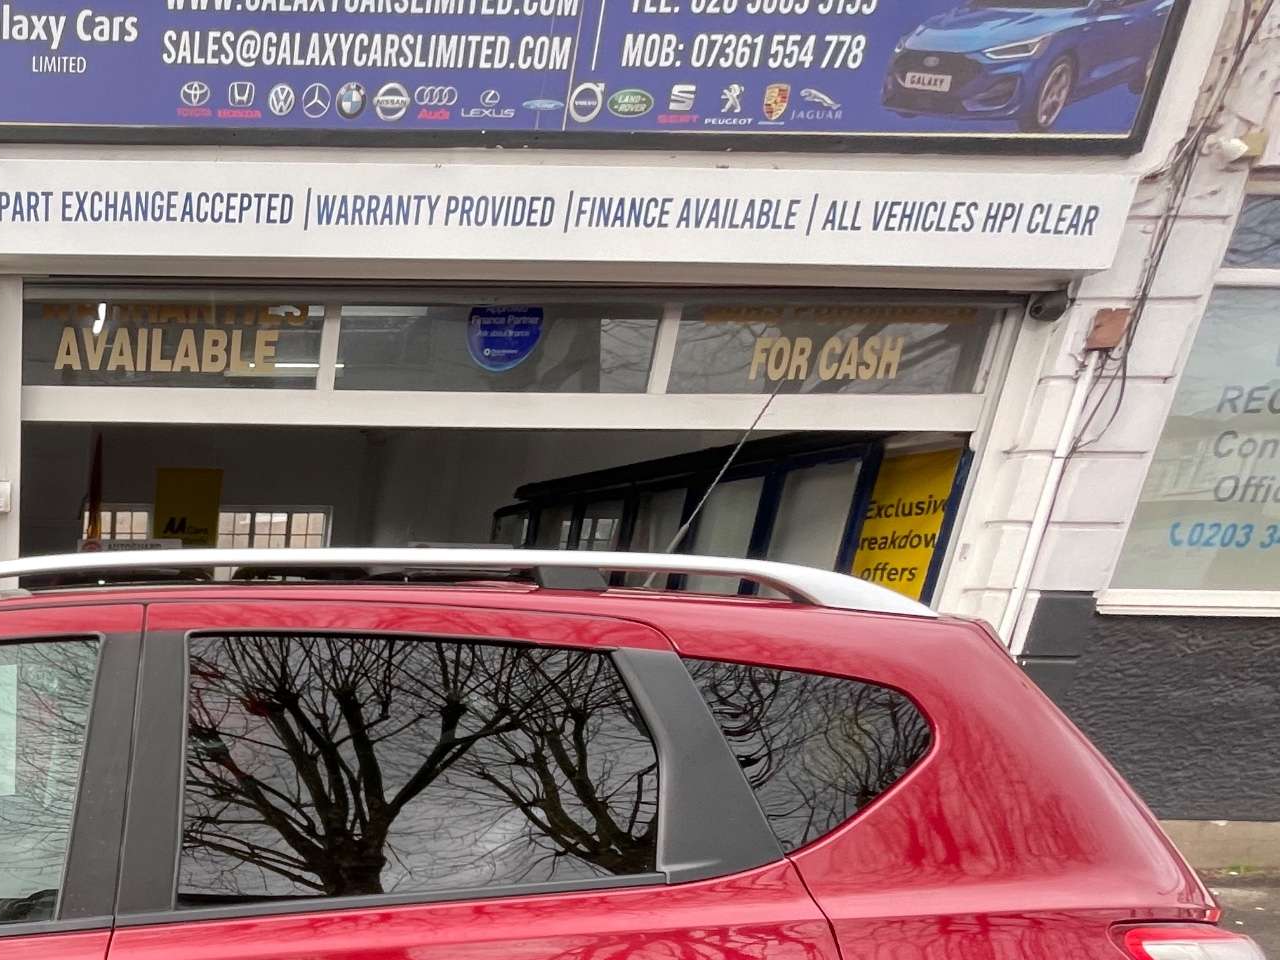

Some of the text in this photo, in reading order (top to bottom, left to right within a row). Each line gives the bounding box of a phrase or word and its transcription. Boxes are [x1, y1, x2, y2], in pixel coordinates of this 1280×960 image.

[76, 7, 139, 43] Cars
[31, 55, 87, 74] LIMITED
[162, 30, 572, 70] SALES@GALAXYCARSLIMITED.COM
[621, 33, 866, 69] MOB: 07361 554 778
[460, 107, 516, 119] LEXUS
[704, 117, 754, 126] PEUGEOT
[789, 109, 843, 121] JAGUAR
[315, 194, 440, 227] WARRANTY
[443, 195, 555, 228] PROVIDED
[574, 197, 673, 229] FINANCE
[676, 198, 801, 231] AVAILABLE
[822, 200, 864, 233] ALL
[871, 200, 979, 234] VEHICLES
[981, 202, 1022, 235] HPI
[1025, 203, 1099, 237] CLEAR
[53, 326, 280, 373] AVAILABLE
[748, 335, 906, 381] FOR CASH
[1186, 522, 1252, 549] 0203
[860, 561, 919, 584] offers
